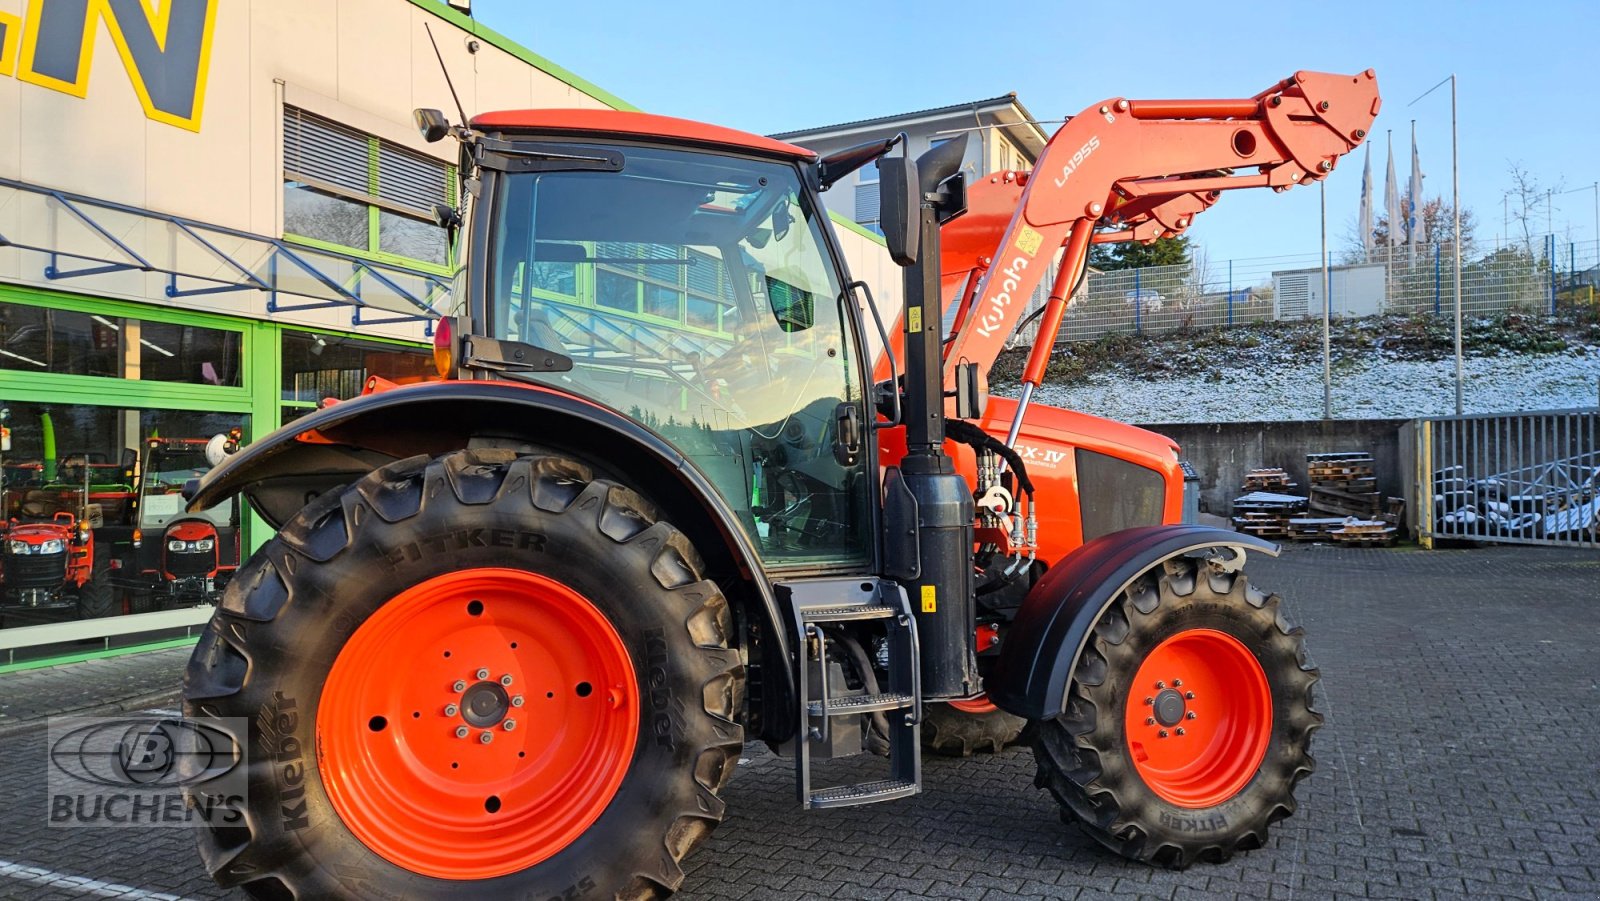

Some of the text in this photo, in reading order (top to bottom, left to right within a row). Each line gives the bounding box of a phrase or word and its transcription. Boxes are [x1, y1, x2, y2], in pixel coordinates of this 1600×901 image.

[0, 0, 219, 133] N
[976, 256, 1028, 338] Kubota
[643, 627, 675, 752] Kleber
[273, 690, 310, 832] Kleber
